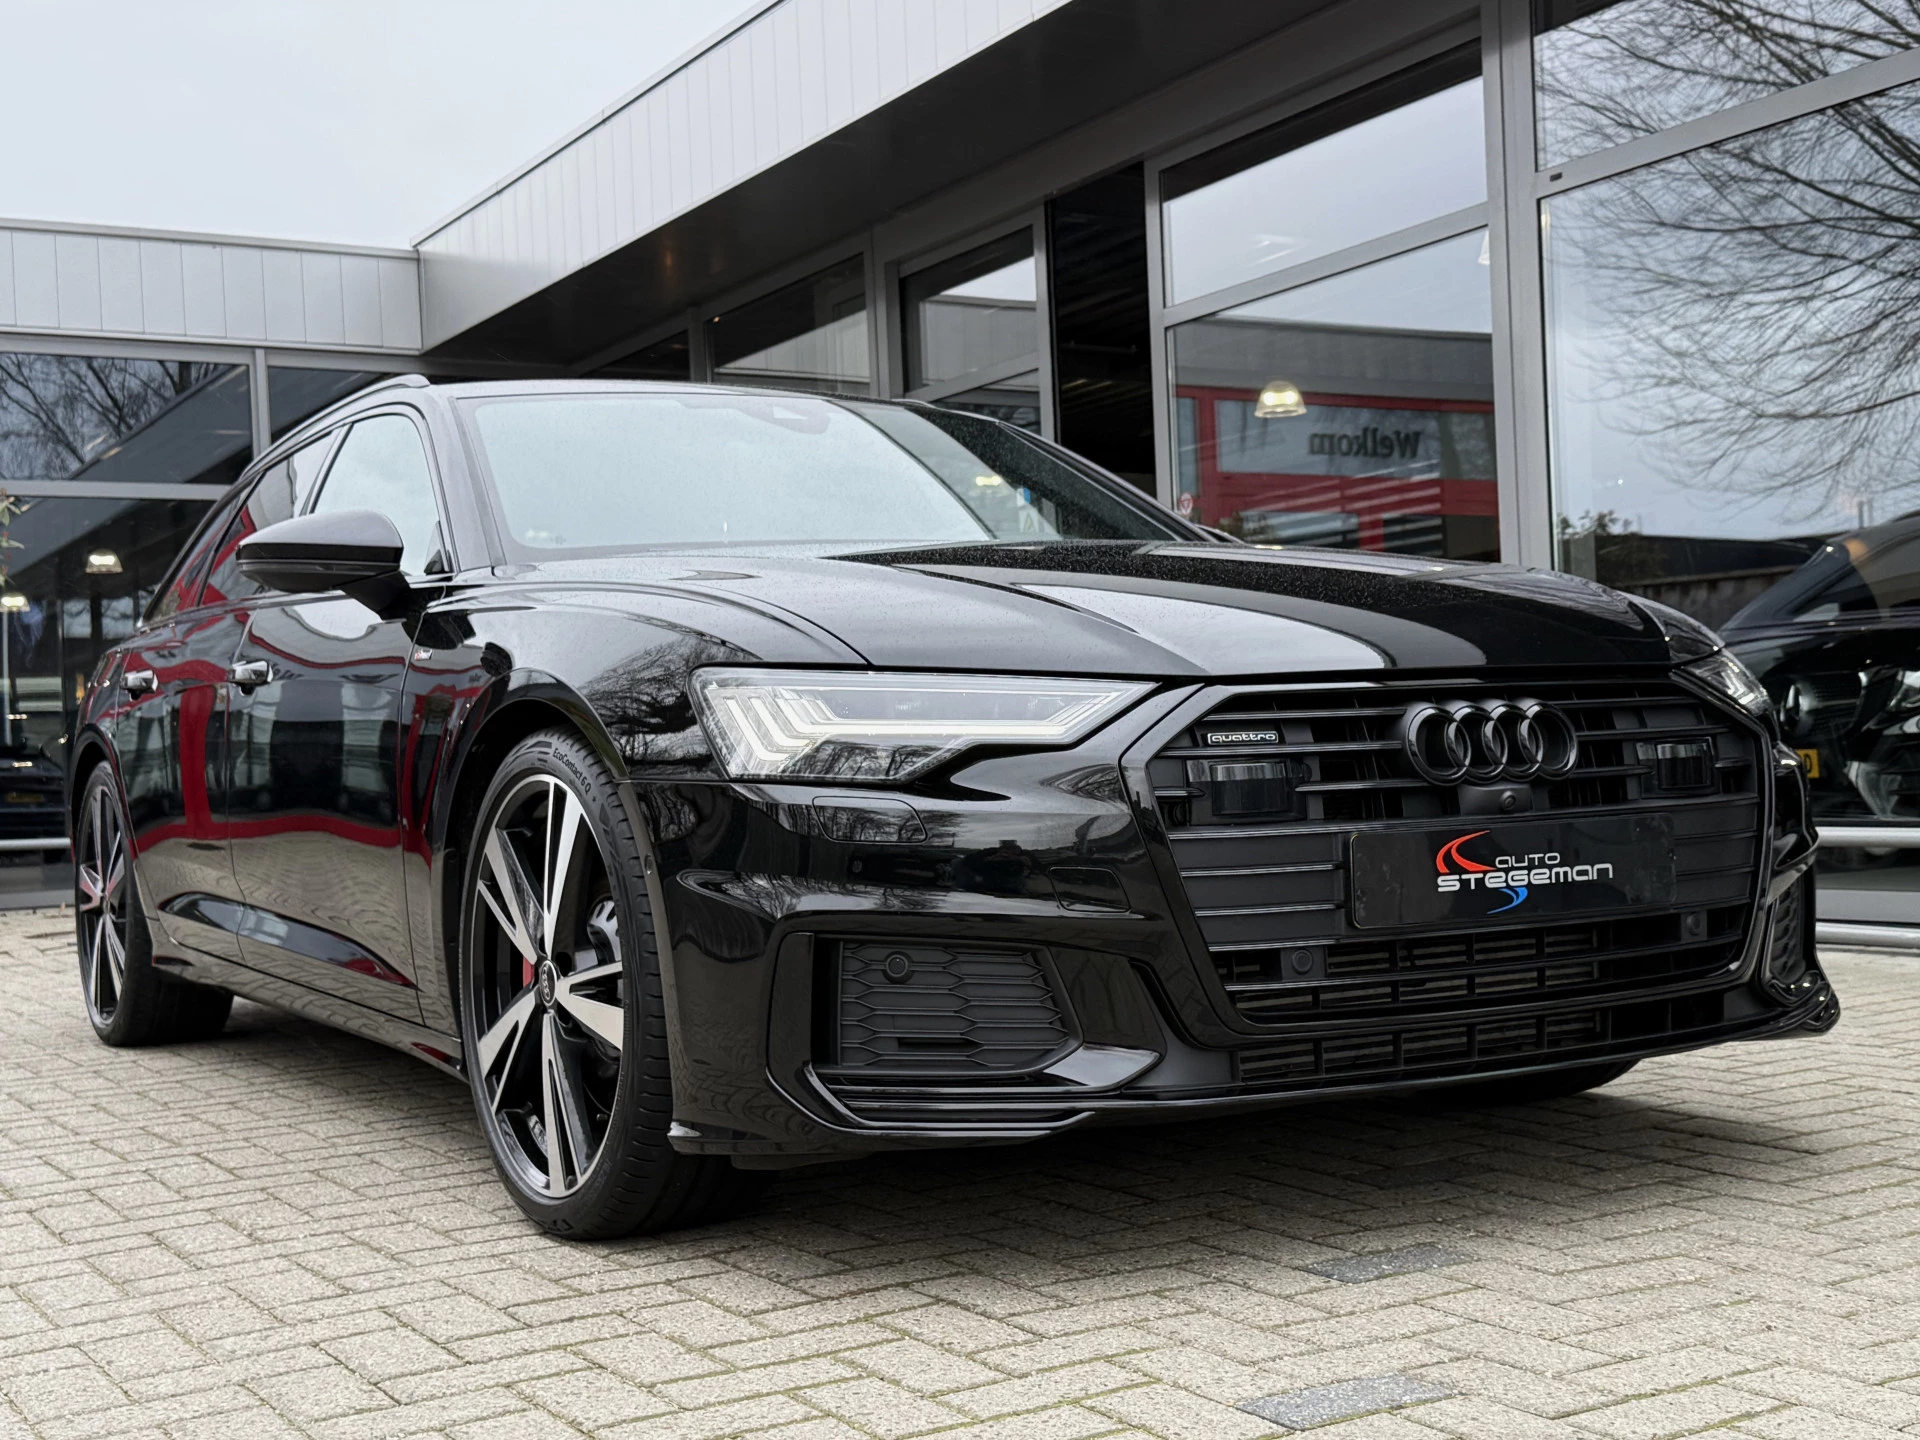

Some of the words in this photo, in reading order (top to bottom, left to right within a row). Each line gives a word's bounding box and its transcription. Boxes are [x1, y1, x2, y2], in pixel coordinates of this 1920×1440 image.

[1211, 733, 1276, 743] quattro
[552, 747, 584, 780] EcoContact
[580, 776, 588, 787] 6
